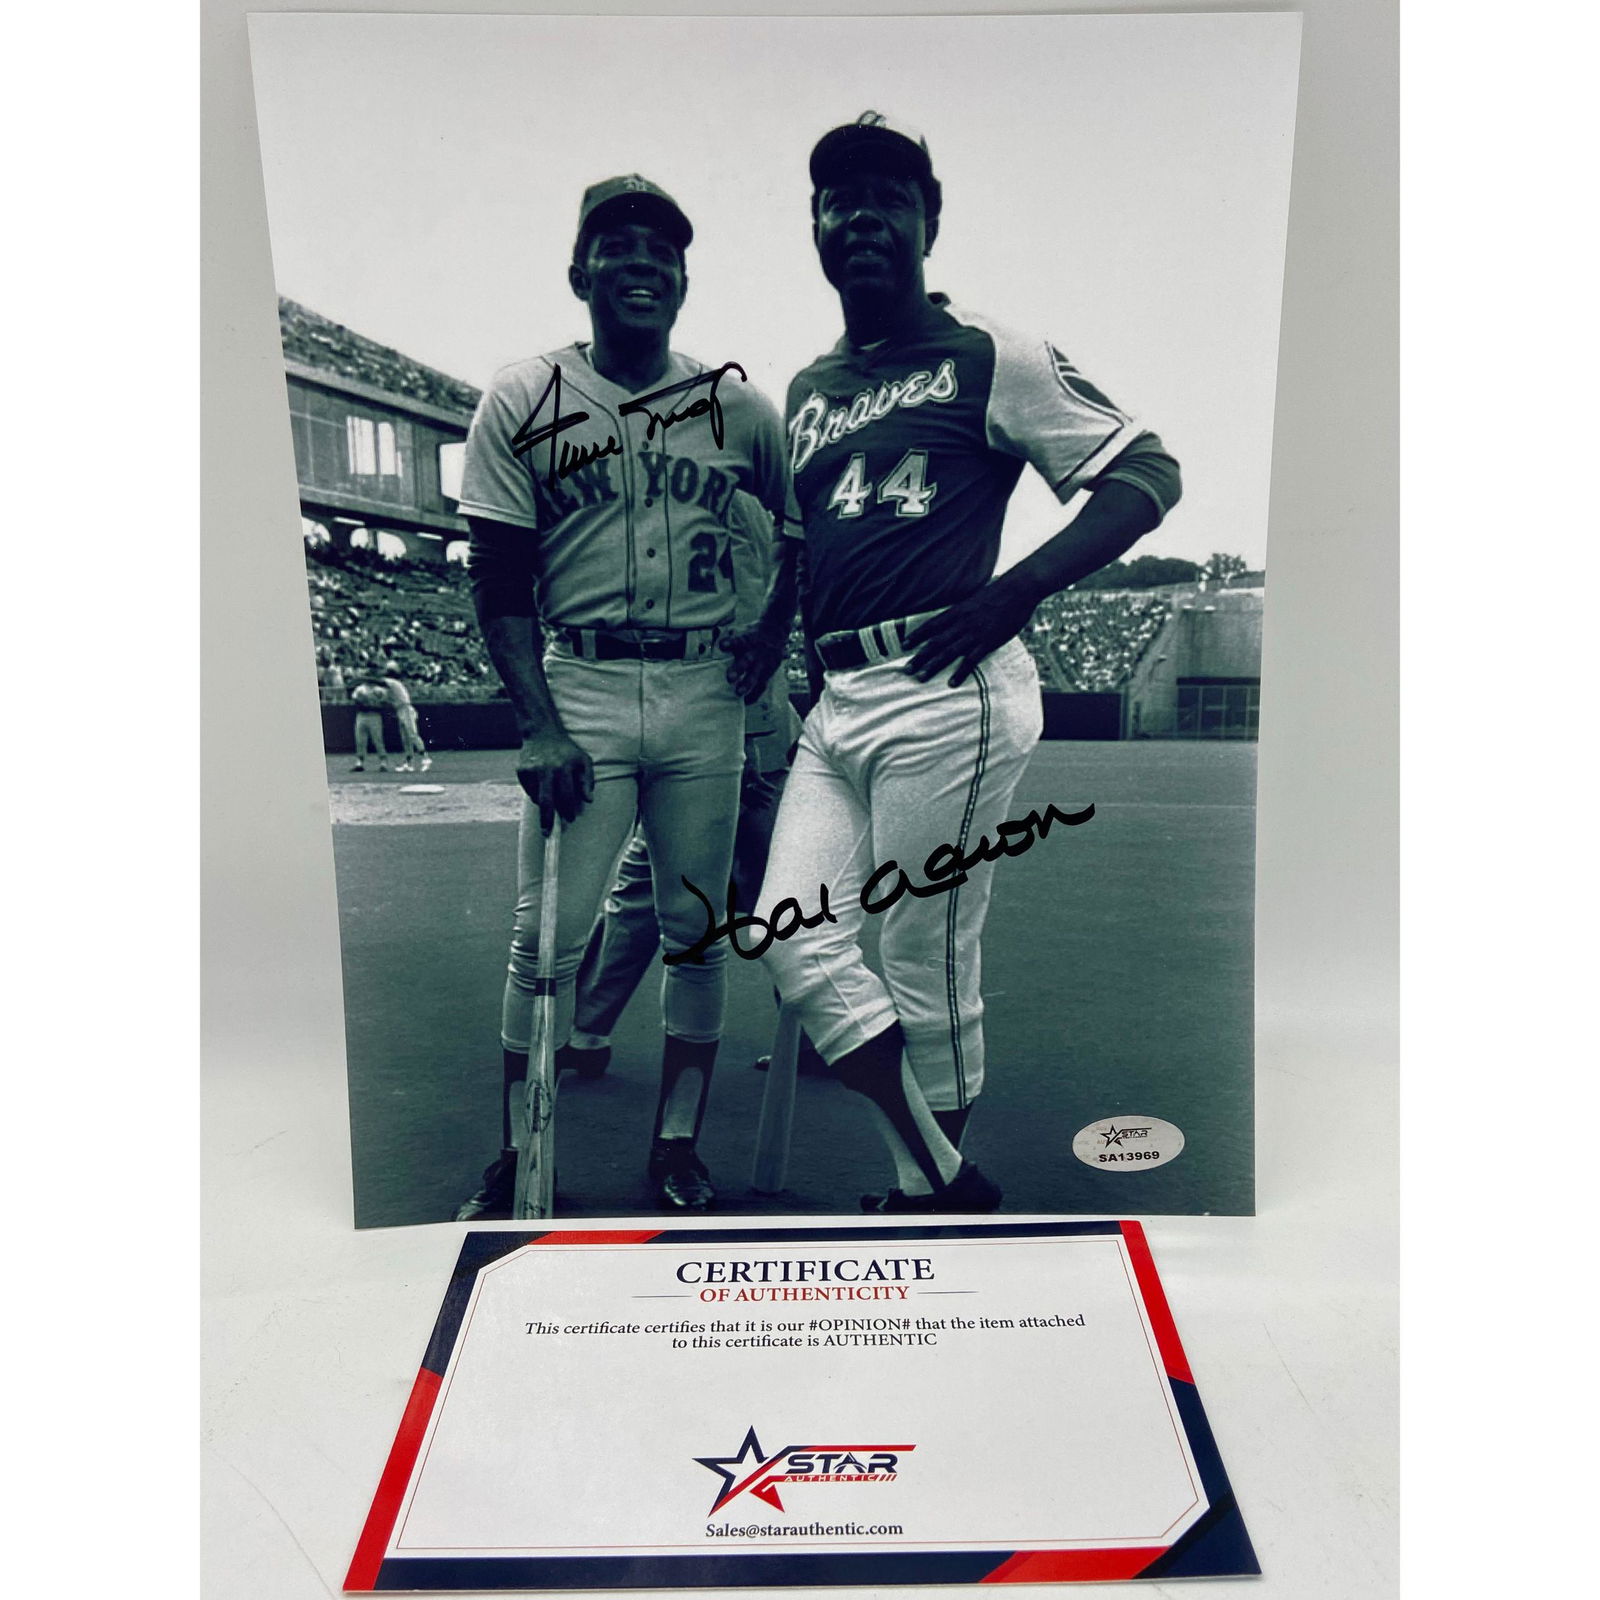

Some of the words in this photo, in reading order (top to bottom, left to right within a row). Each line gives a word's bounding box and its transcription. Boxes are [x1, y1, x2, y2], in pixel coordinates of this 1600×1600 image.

[788, 359, 959, 473] Braves
[638, 452, 736, 514] YOR
[827, 448, 937, 519] 44
[1121, 1130, 1149, 1138] STAR
[1099, 1151, 1160, 1163] SA13969
[676, 1259, 935, 1283] CERTIFICATE
[699, 1288, 730, 1302] OF
[736, 1286, 910, 1302] AUTHENTICITY
[525, 1322, 559, 1335] This
[564, 1321, 640, 1334] certificate
[644, 1321, 706, 1334] certifies
[709, 1320, 741, 1333] that
[745, 1320, 757, 1332] it
[760, 1320, 773, 1332] is
[777, 1322, 805, 1332] our
[809, 1318, 911, 1332] #OPINION#
[916, 1317, 946, 1330] that
[950, 1317, 976, 1330] the
[979, 1316, 1015, 1329] item
[1019, 1314, 1086, 1328] attached
[672, 1337, 687, 1349] to
[692, 1336, 721, 1348] this
[725, 1335, 803, 1348] certificate
[807, 1334, 820, 1347] is
[824, 1333, 938, 1347] AUTHENTIC
[785, 1452, 899, 1474] STAR
[784, 1474, 876, 1482] AUTHENTIC
[705, 1522, 904, 1537] Sales@starauthentic.com
